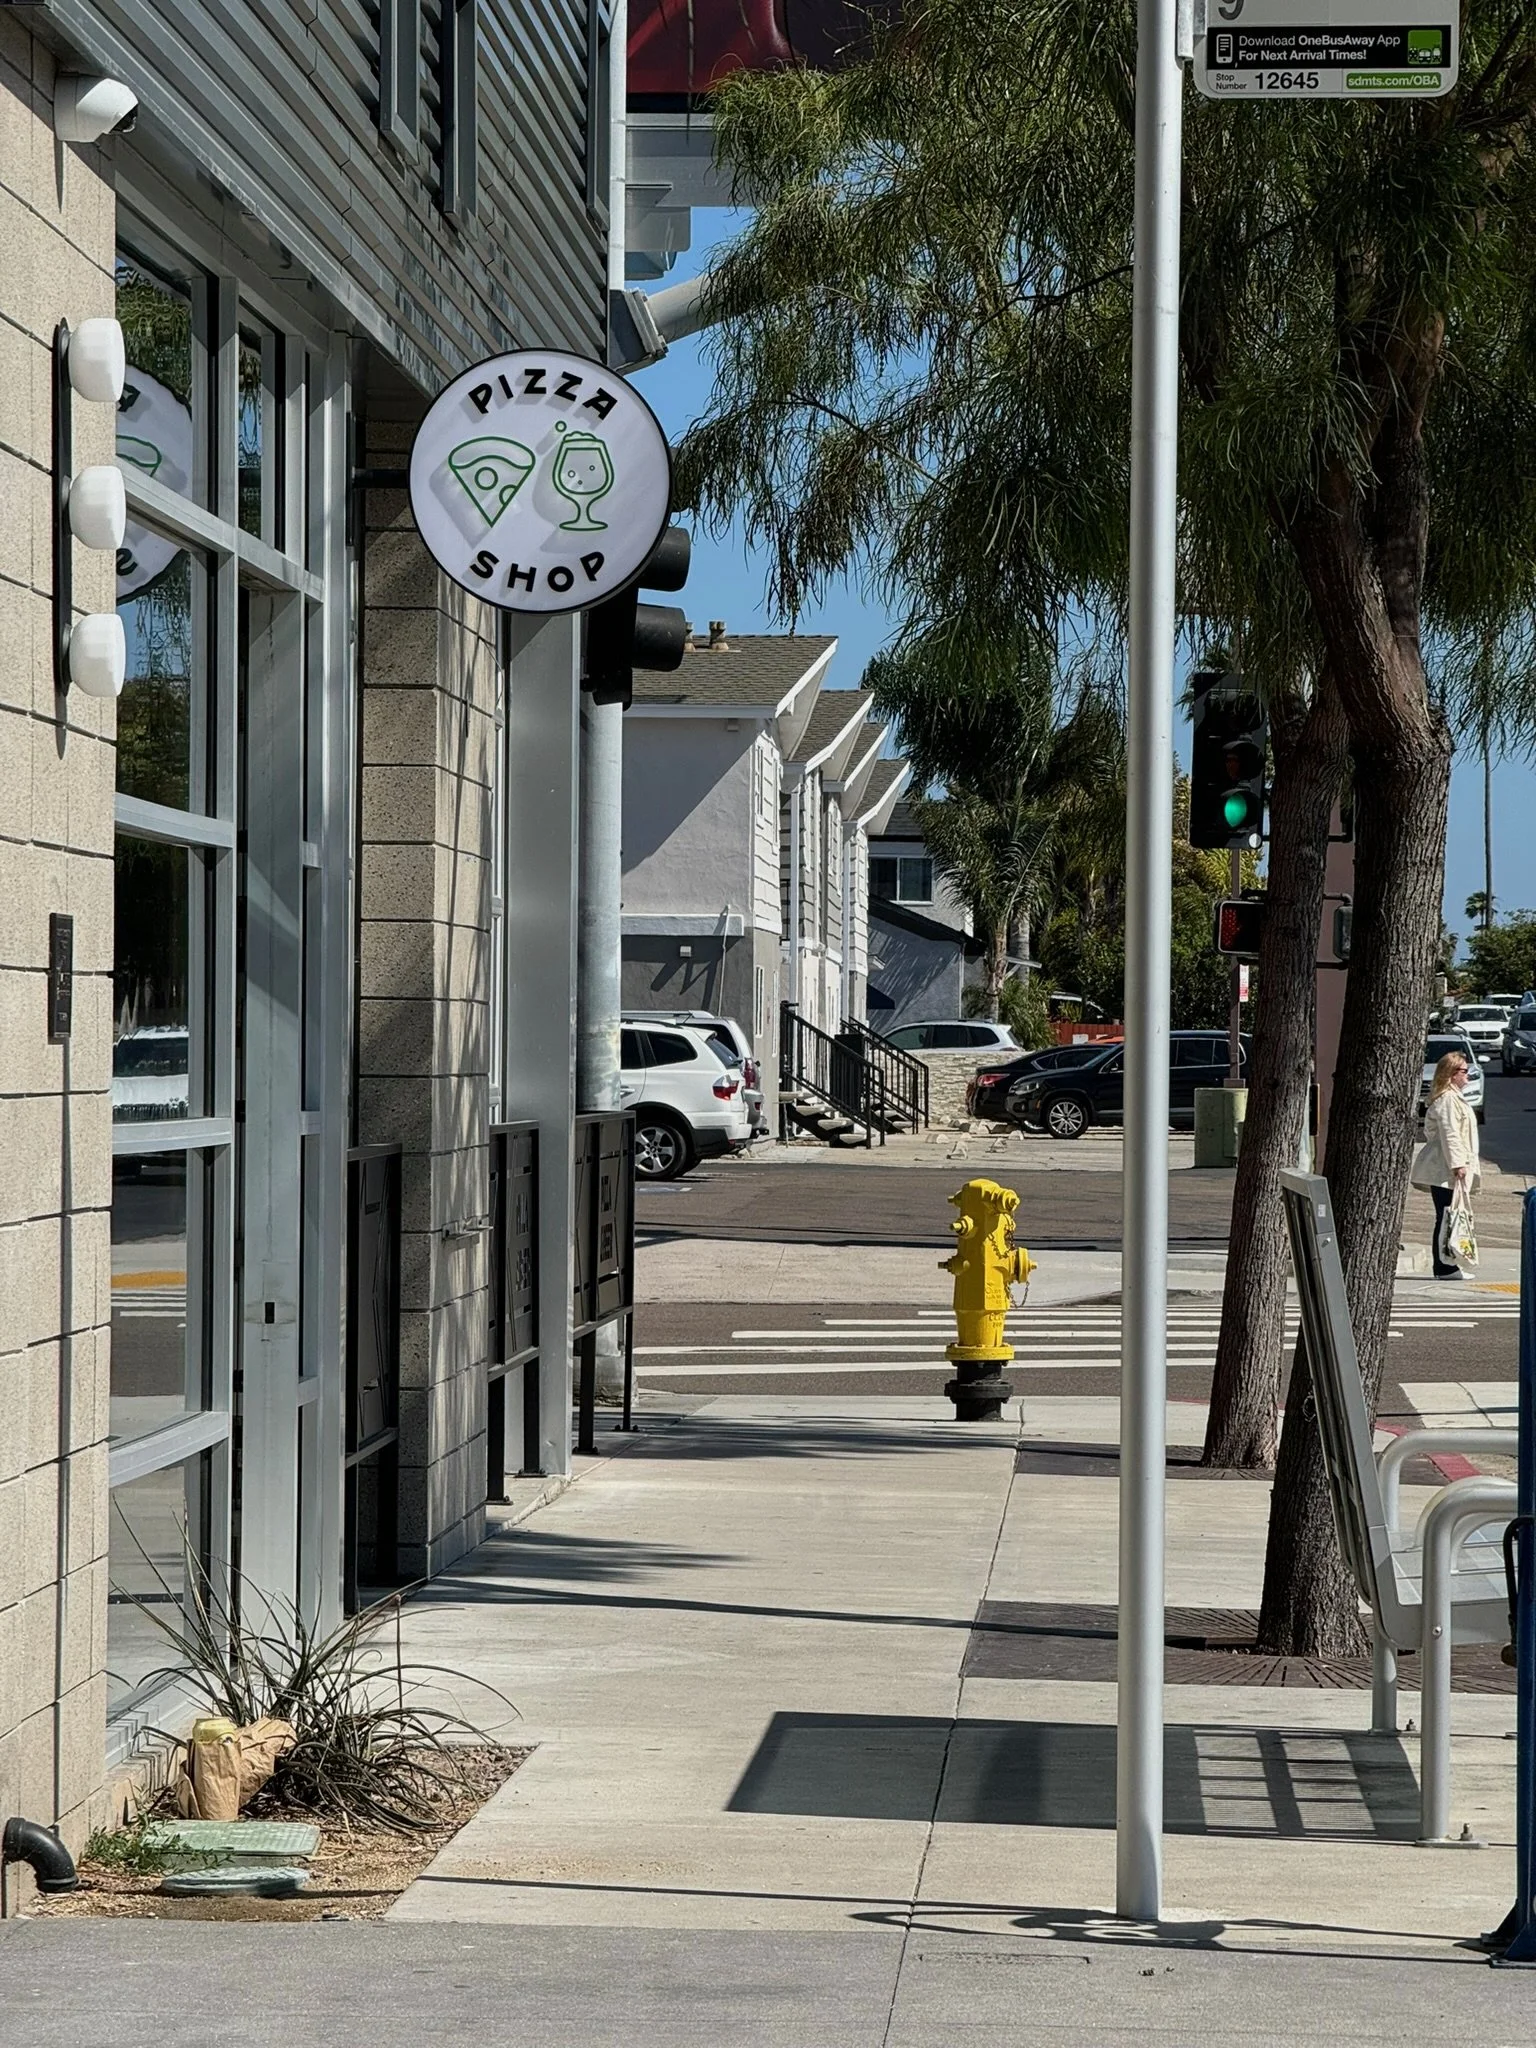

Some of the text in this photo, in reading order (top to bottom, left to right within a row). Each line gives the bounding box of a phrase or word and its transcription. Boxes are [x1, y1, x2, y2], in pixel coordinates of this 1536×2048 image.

[1239, 34, 1401, 47] Download OneBusAway App
[1239, 49, 1367, 60] For Next Arrival Times!
[1216, 73, 1235, 82] Stop
[1255, 71, 1319, 89] 12645
[1348, 74, 1440, 87] sdmts.com/OBA
[468, 368, 618, 421] PIZZA
[470, 550, 605, 593] SHOP
